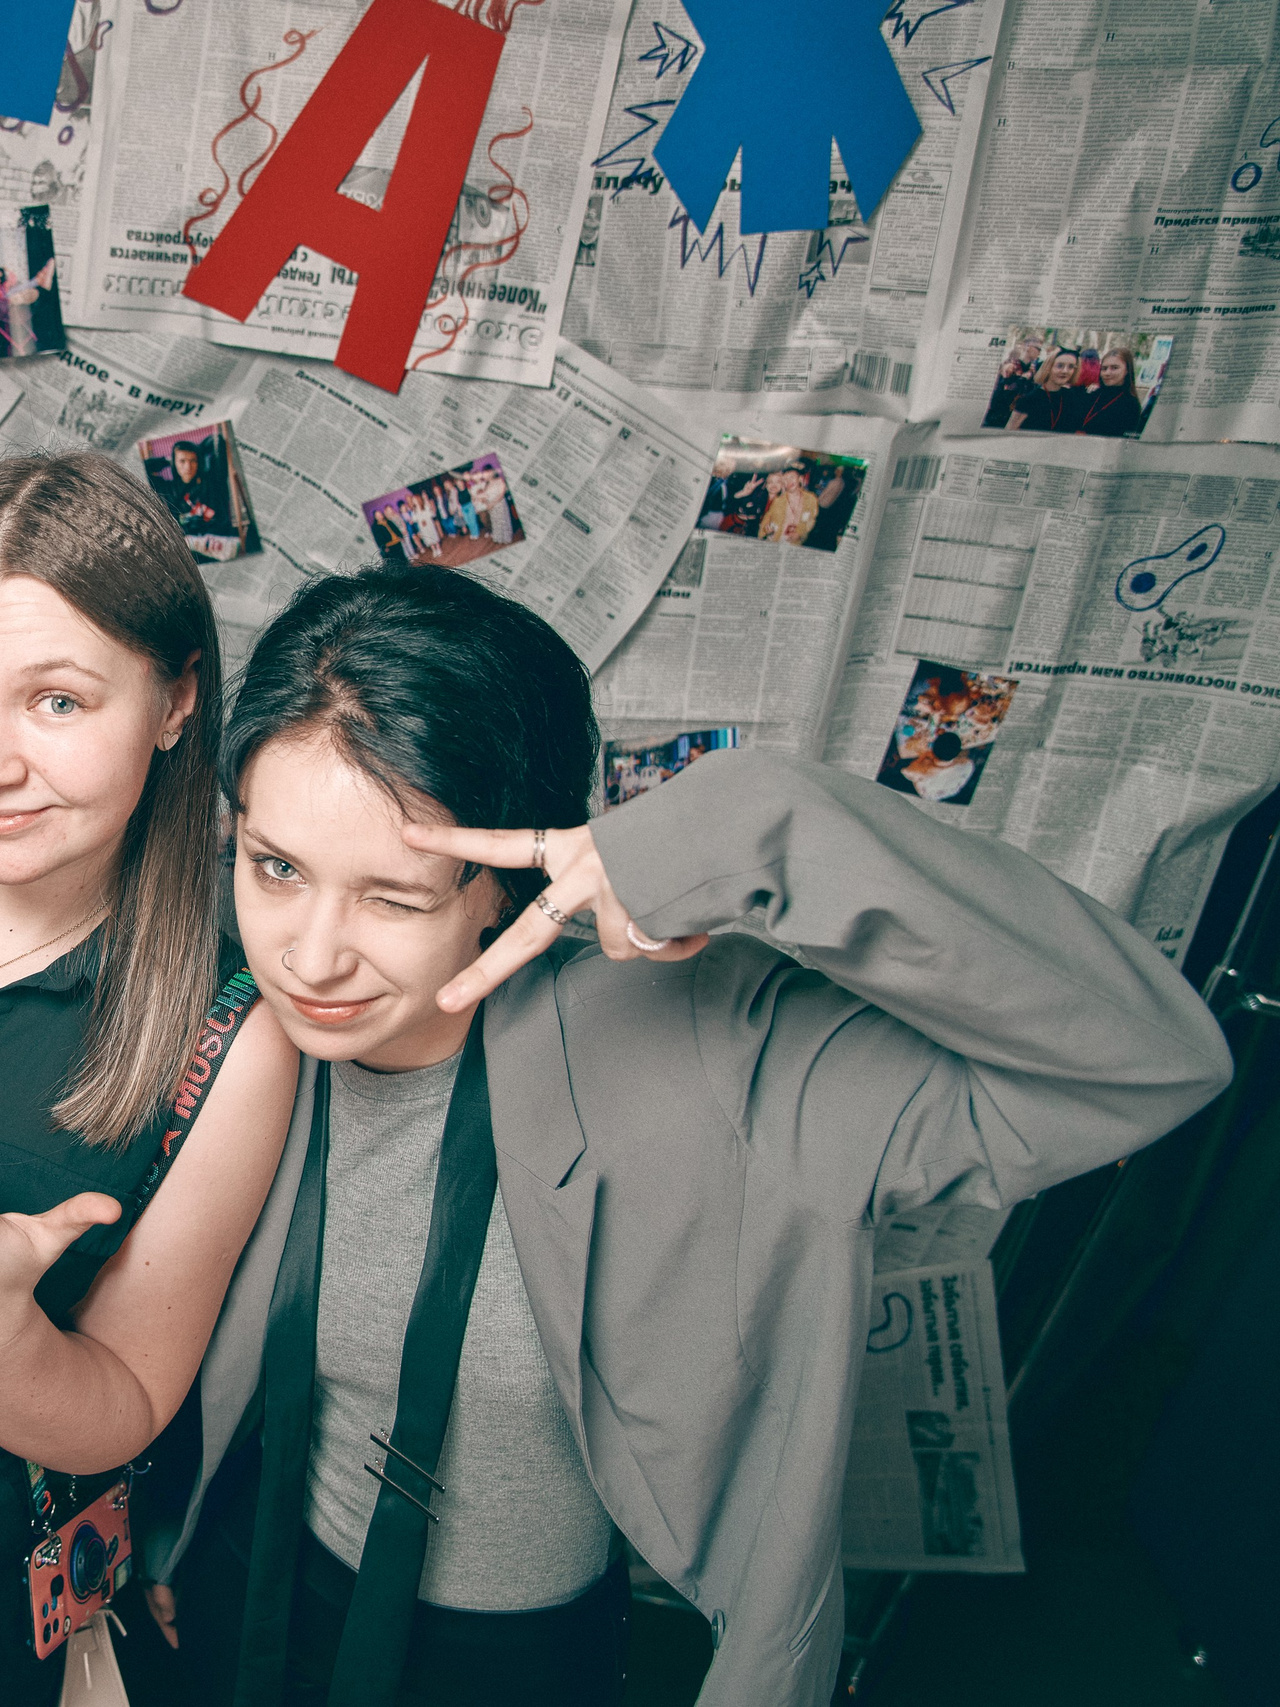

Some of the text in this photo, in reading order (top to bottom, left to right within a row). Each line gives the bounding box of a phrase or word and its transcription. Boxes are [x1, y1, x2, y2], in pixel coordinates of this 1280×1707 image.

[1153, 215, 1220, 228] Придётся
[109, 246, 189, 264] начинается
[1150, 303, 1277, 316] Накануне праздника
[57, 349, 111, 384] дкое
[144, 393, 206, 418] меру!
[1007, 660, 1088, 676] нравится!
[1090, 665, 1125, 679] нам
[1126, 668, 1237, 692] постоянство
